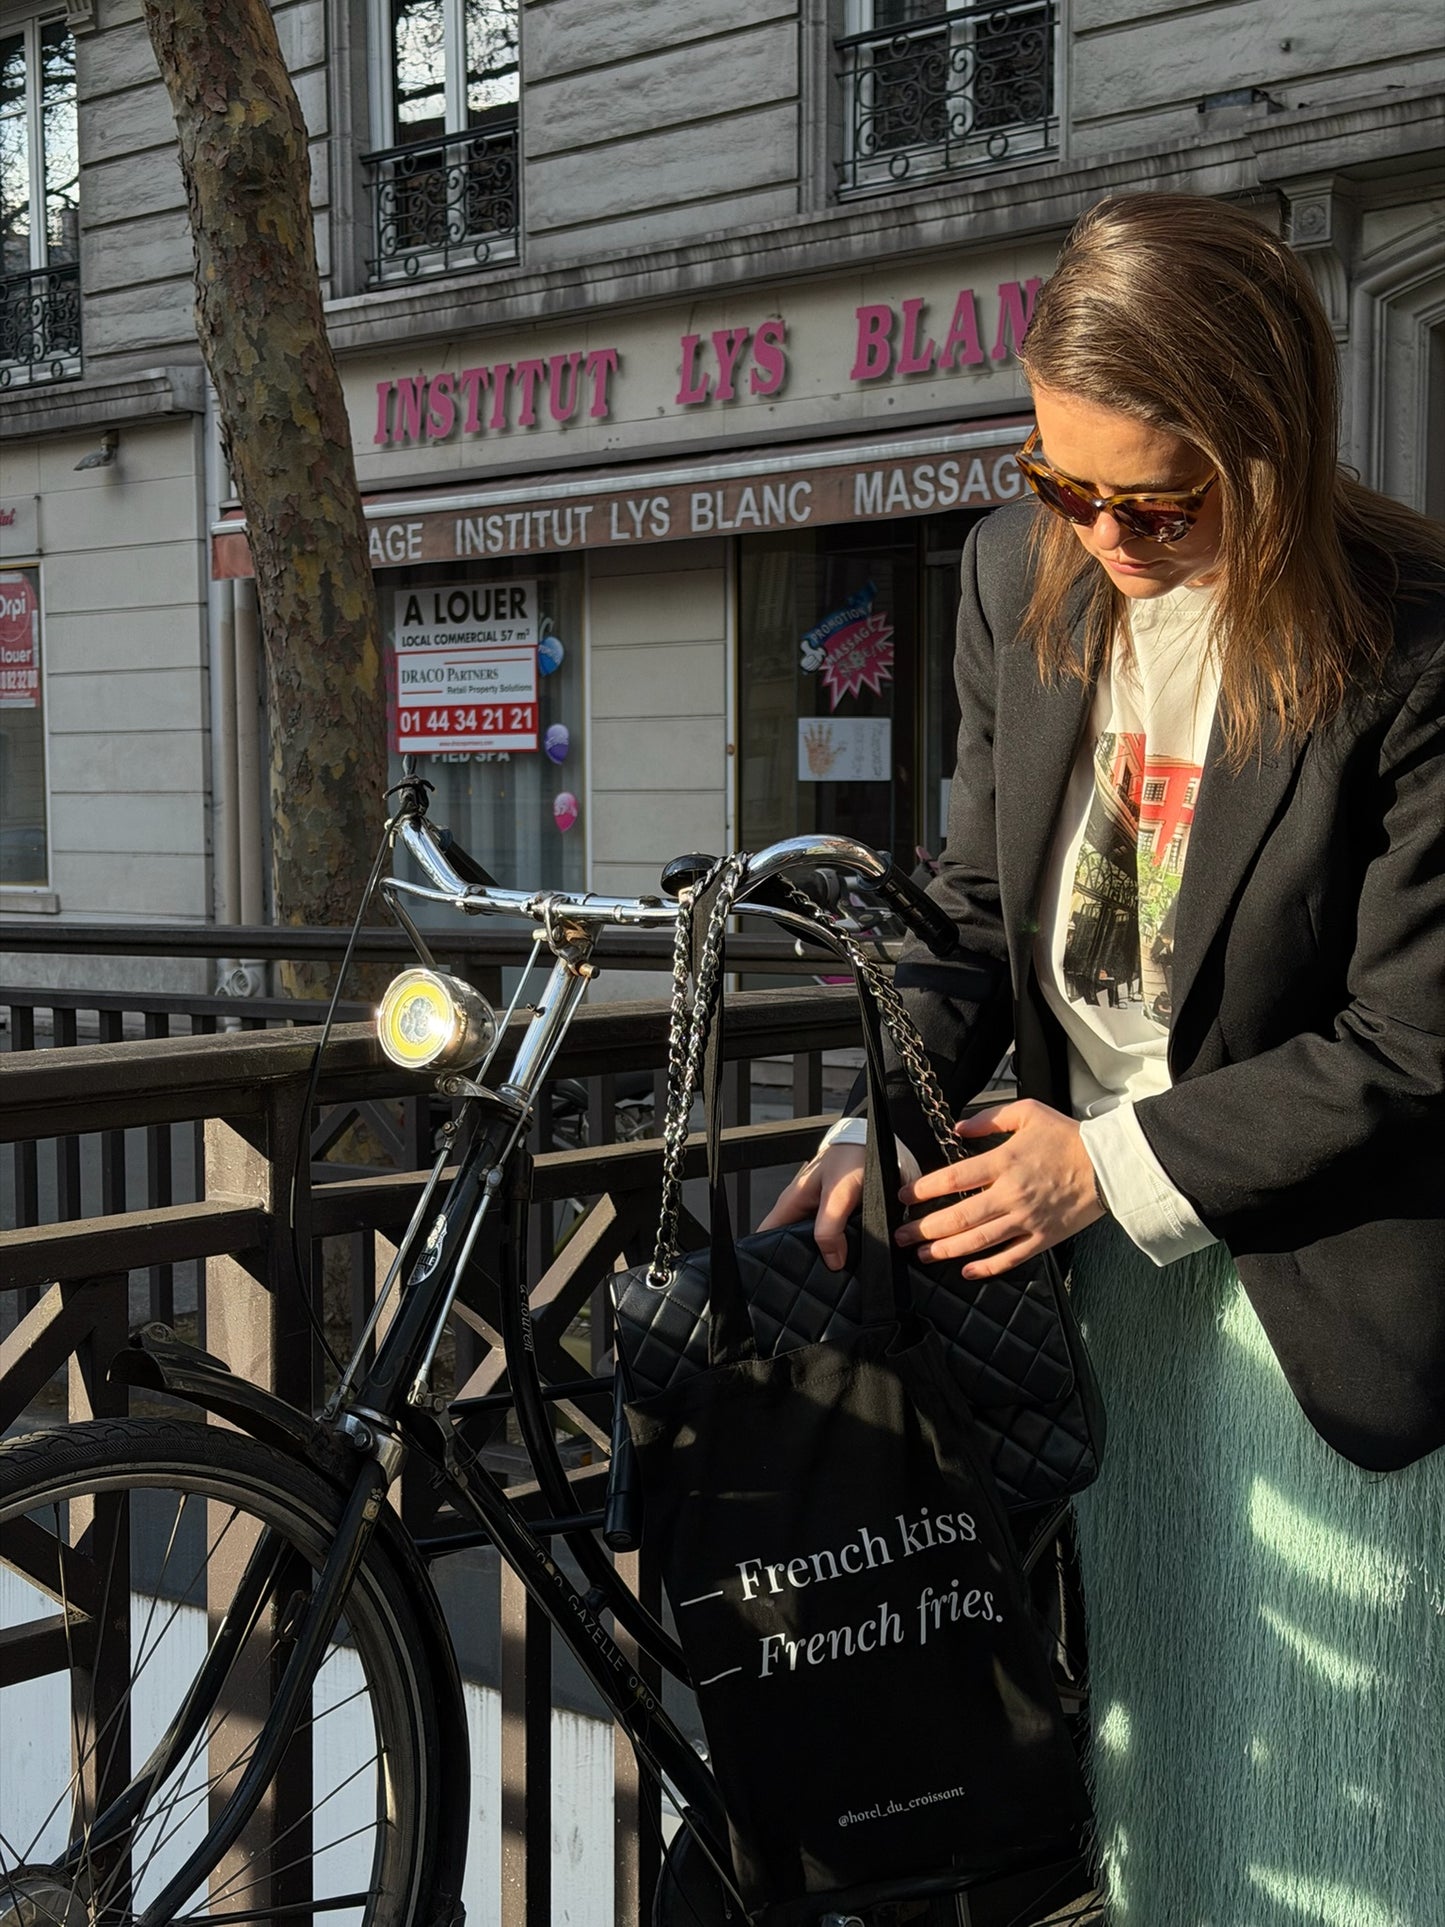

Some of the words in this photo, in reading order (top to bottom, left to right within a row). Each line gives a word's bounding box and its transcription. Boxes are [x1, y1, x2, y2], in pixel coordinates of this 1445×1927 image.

[374, 348, 618, 444] INSTITUT
[675, 319, 786, 404] LYS
[455, 506, 594, 555] INSTITUT
[610, 496, 670, 541] LYS
[691, 481, 812, 532] BLANC
[854, 453, 1036, 516] MASSAG
[403, 595, 424, 626] A
[434, 587, 528, 625] LOUER
[811, 608, 866, 643] PROMOTION
[1, 648, 31, 664] louer
[402, 635, 431, 647] LOCAL
[434, 631, 498, 645] COMMERCIAL
[500, 630, 514, 642] 57
[826, 619, 875, 668] MASSAGE
[401, 668, 444, 684] DRACO
[447, 685, 467, 695] Retail
[468, 685, 498, 696] Property
[499, 683, 532, 693] Solutions
[400, 711, 420, 733] 01
[426, 710, 450, 732] 44
[454, 709, 478, 731] 34
[482, 708, 503, 730] 21
[510, 707, 532, 729] 21
[735, 1526, 895, 1601] French
[895, 1507, 978, 1558] kiss
[568, 1594, 624, 1672] GAZELLE
[758, 1601, 905, 1679] French
[916, 1579, 1004, 1645] fries.
[837, 1786, 966, 1828] @hotel_du_croissant
